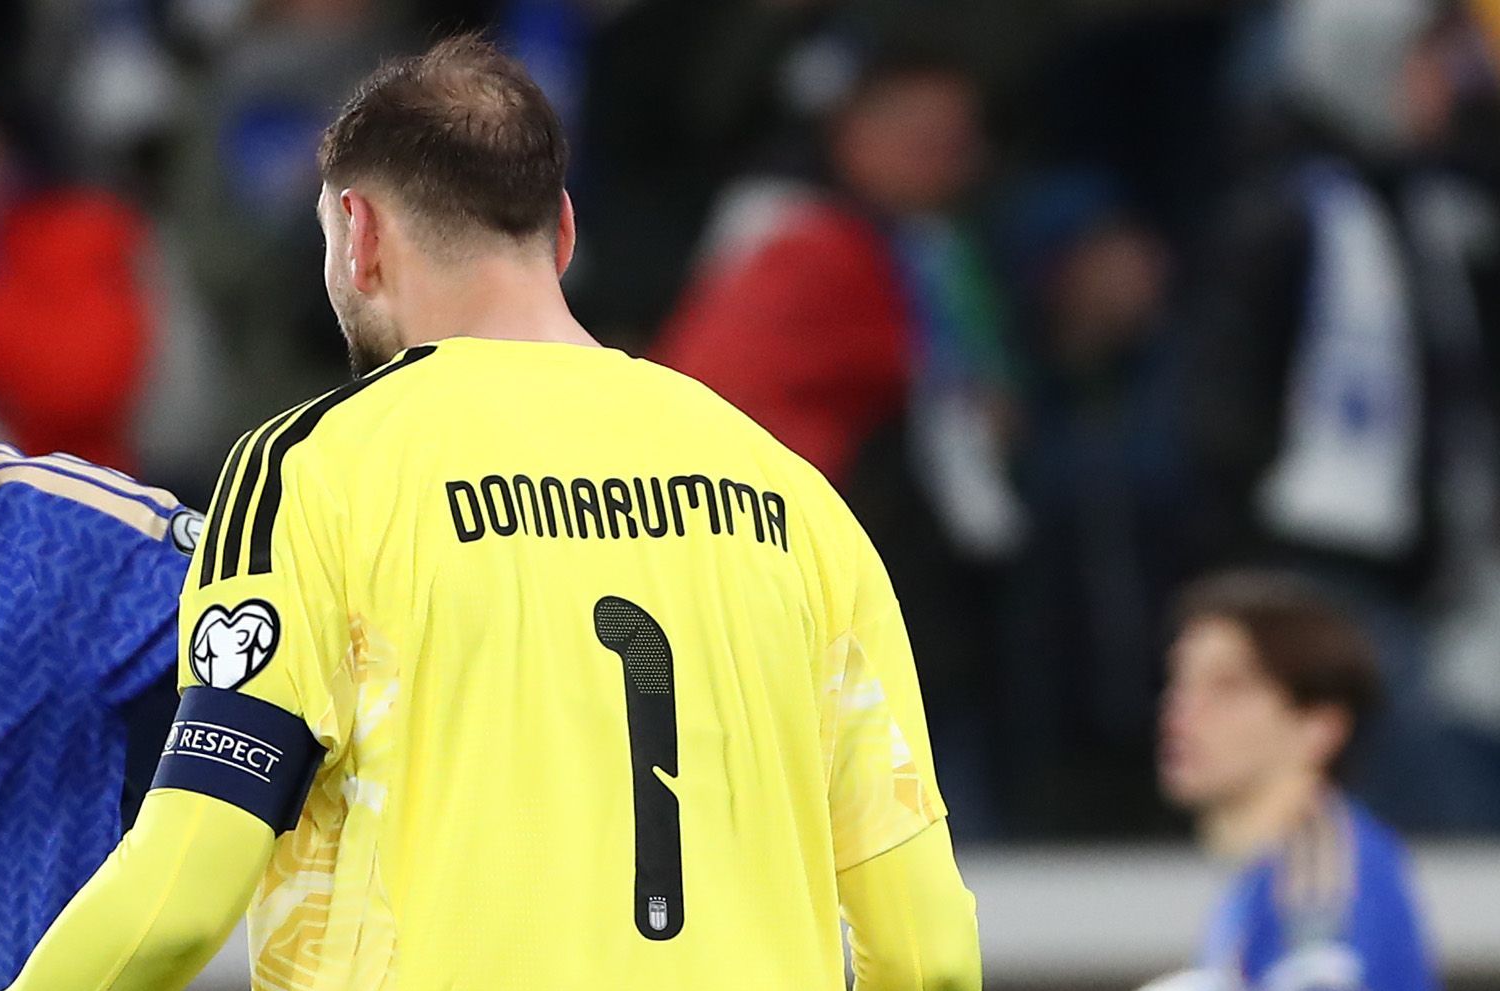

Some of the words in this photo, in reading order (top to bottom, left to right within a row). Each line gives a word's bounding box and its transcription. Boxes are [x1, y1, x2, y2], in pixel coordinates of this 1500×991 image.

[446, 474, 788, 552] DONNARUMMA
[179, 728, 280, 773] RESPECT
[594, 595, 685, 941] 1
